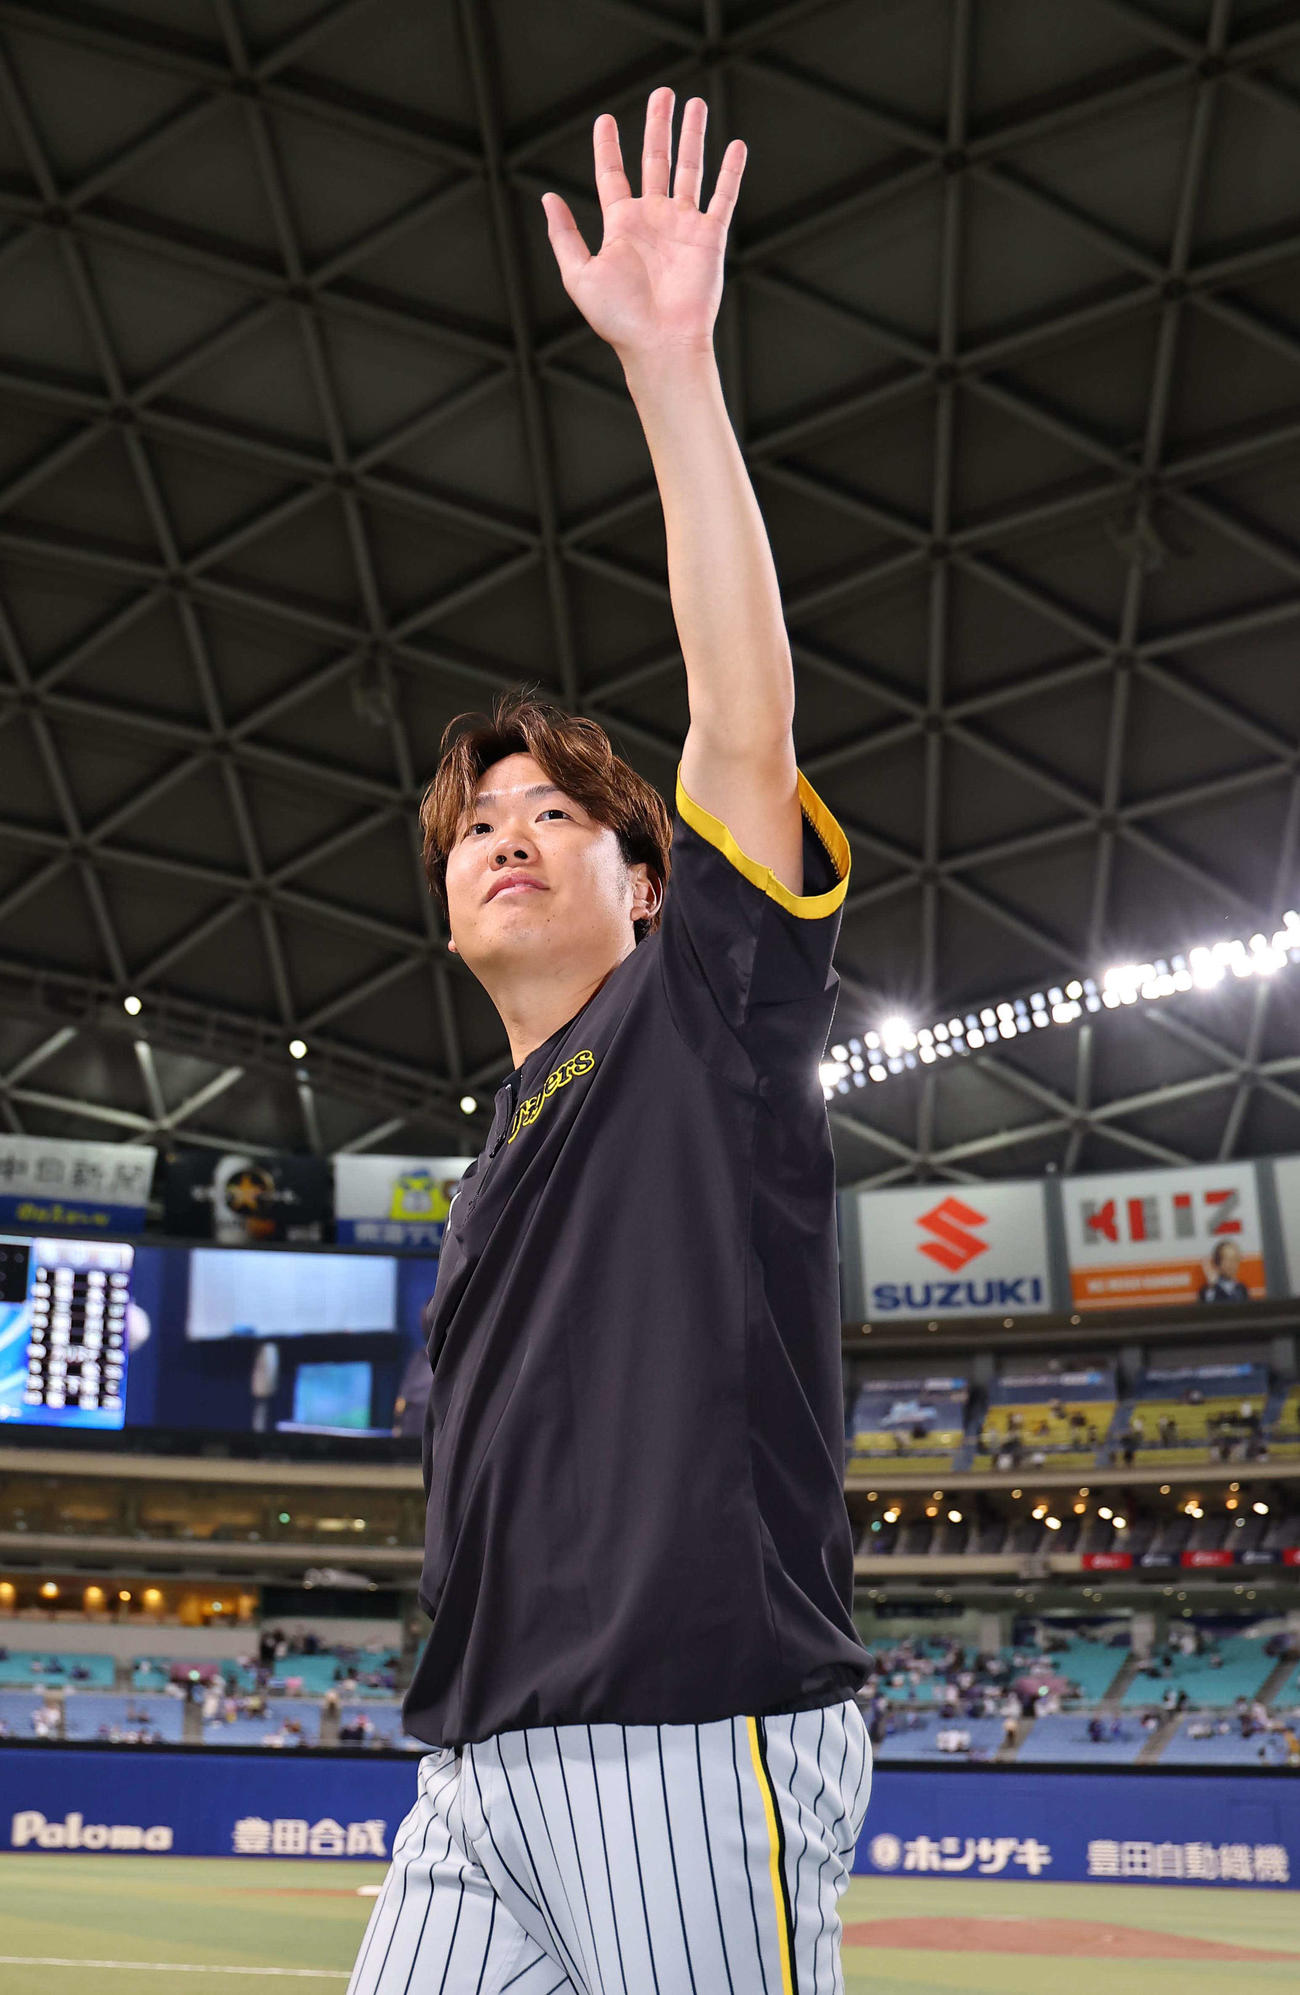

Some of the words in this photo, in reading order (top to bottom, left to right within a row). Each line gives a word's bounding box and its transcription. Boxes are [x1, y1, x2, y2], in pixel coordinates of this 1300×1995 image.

[873, 1278, 1042, 1310] SUZUKI
[12, 1811, 174, 1851] Paloma
[232, 1816, 387, 1857] 豊田合成
